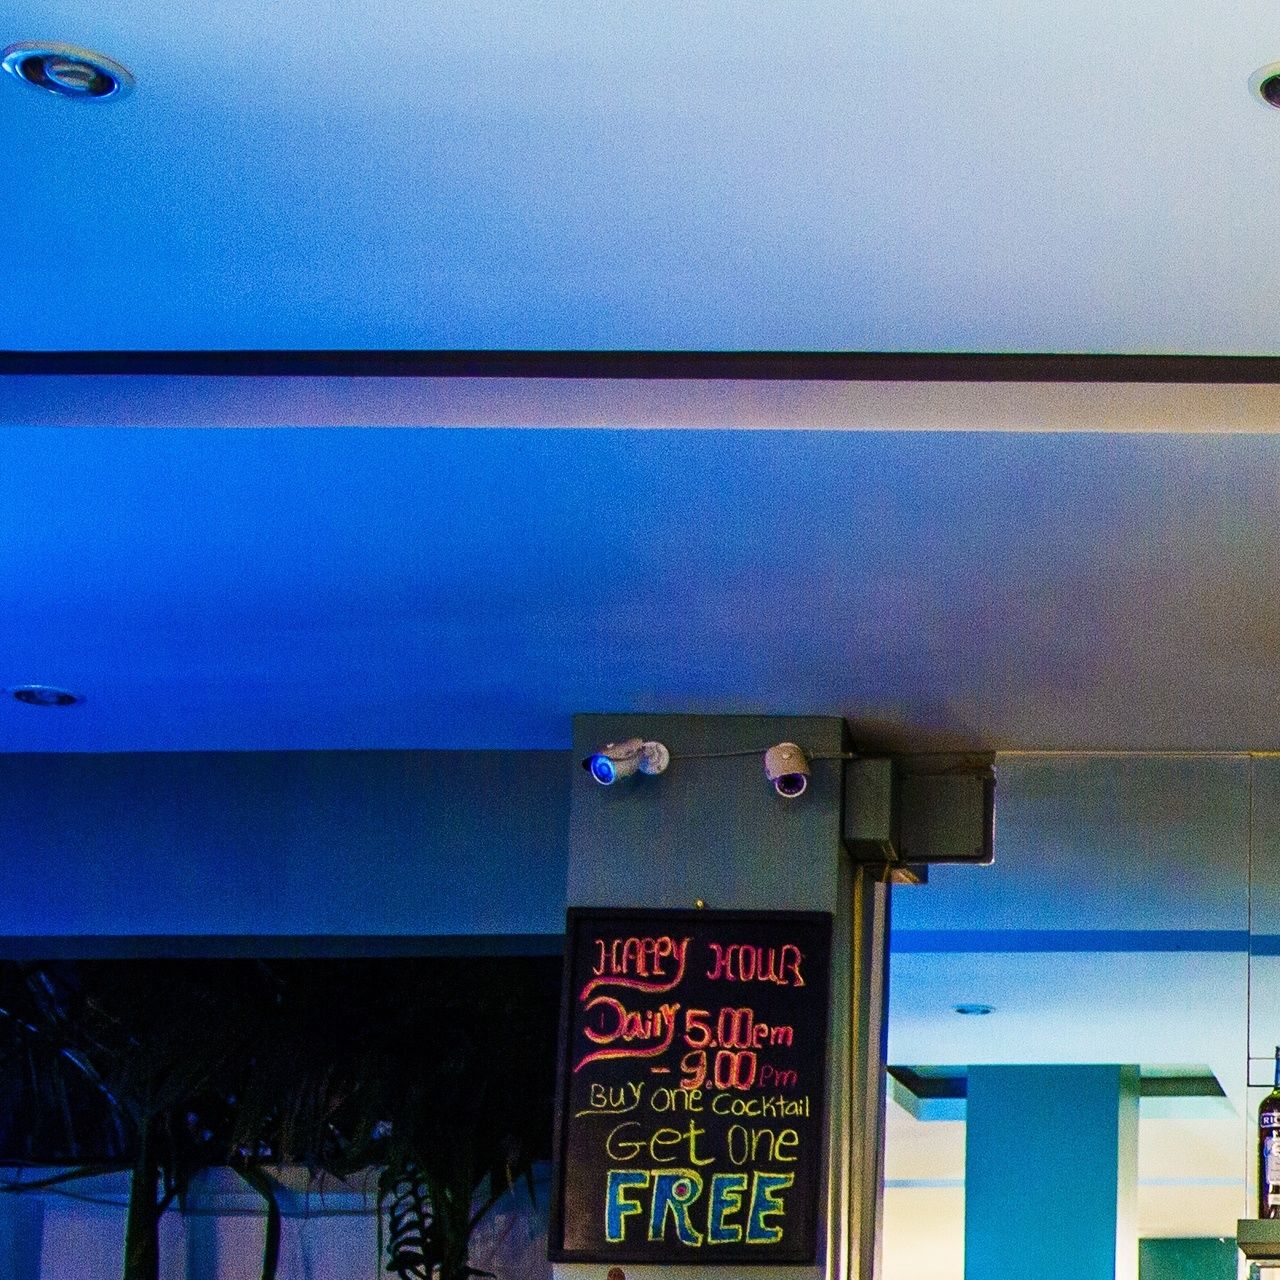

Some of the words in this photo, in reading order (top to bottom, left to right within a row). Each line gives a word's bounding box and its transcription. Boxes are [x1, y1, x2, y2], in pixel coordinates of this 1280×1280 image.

[582, 936, 692, 990] HAPPY
[706, 942, 806, 986] HOUR
[606, 1121, 716, 1166] Get
[605, 1168, 796, 1247] FREE
